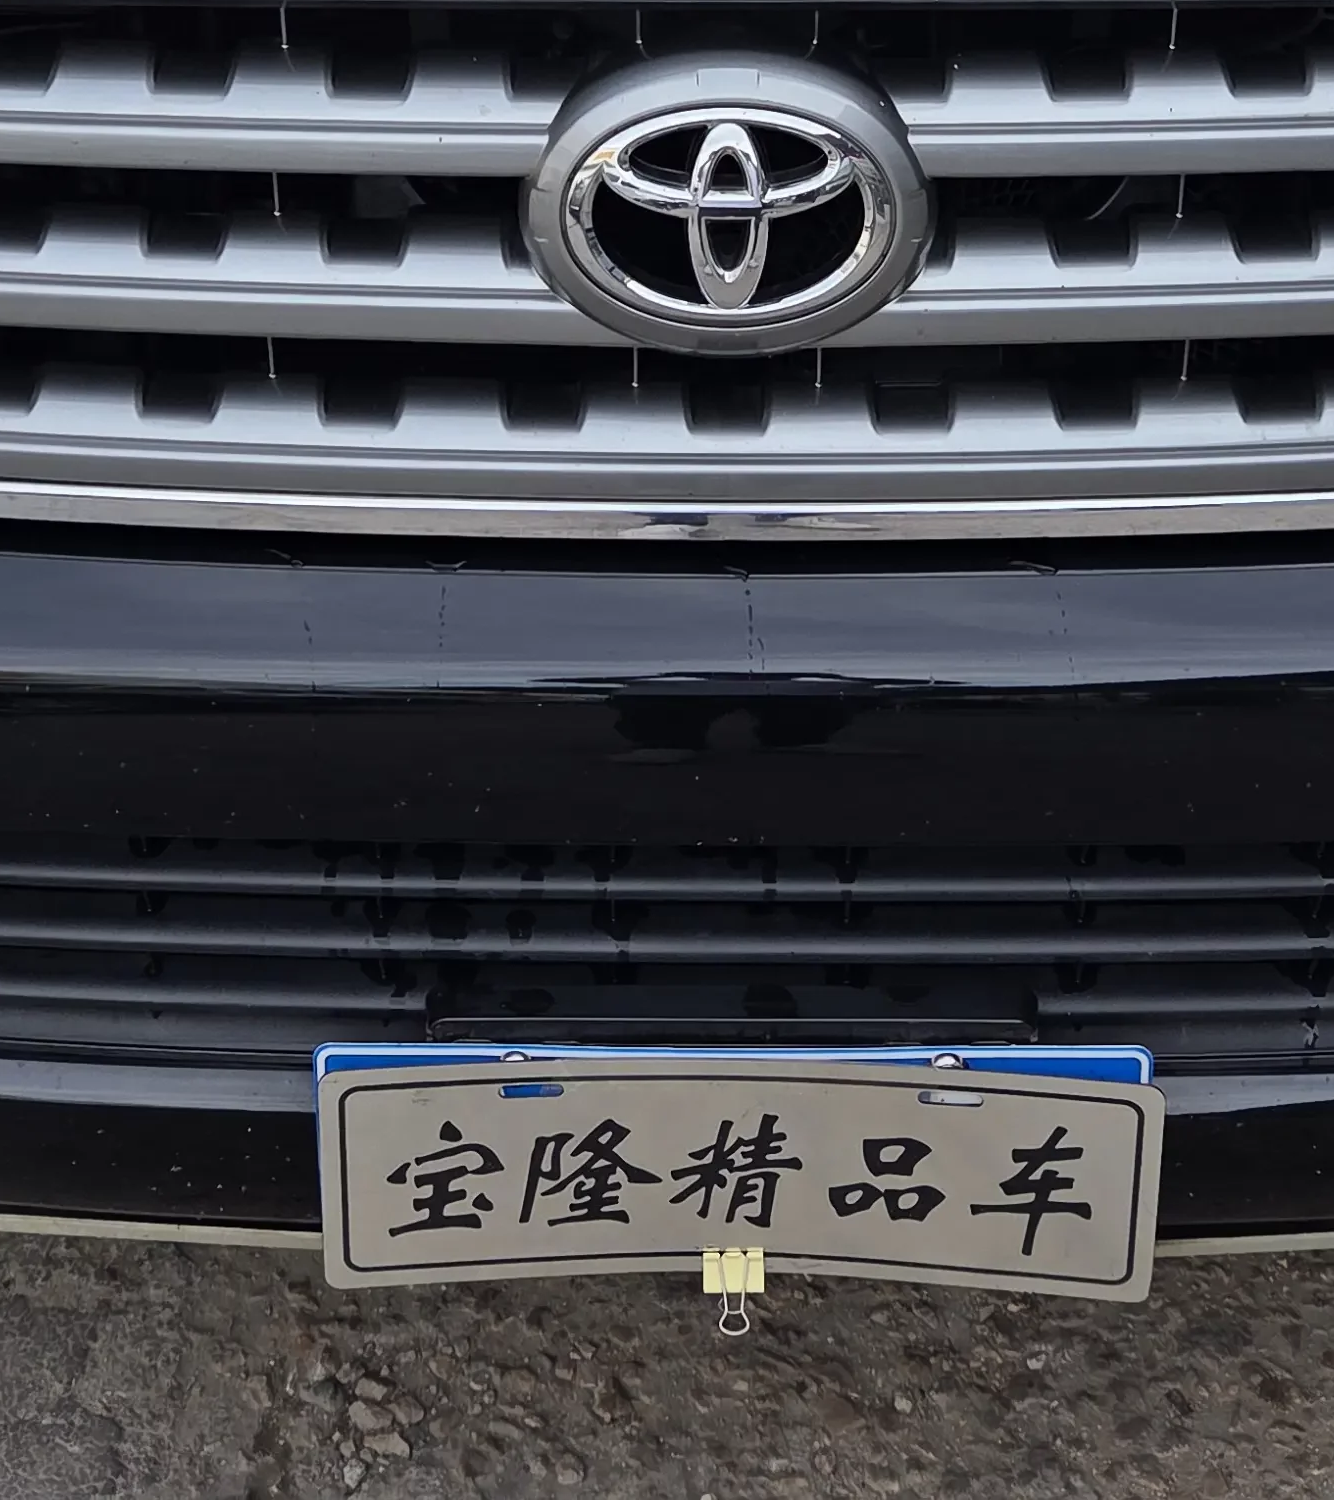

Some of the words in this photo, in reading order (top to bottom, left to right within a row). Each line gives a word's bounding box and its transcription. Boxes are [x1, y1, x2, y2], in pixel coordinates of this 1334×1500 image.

[387, 1114, 1091, 1256] 宝隆精品车
